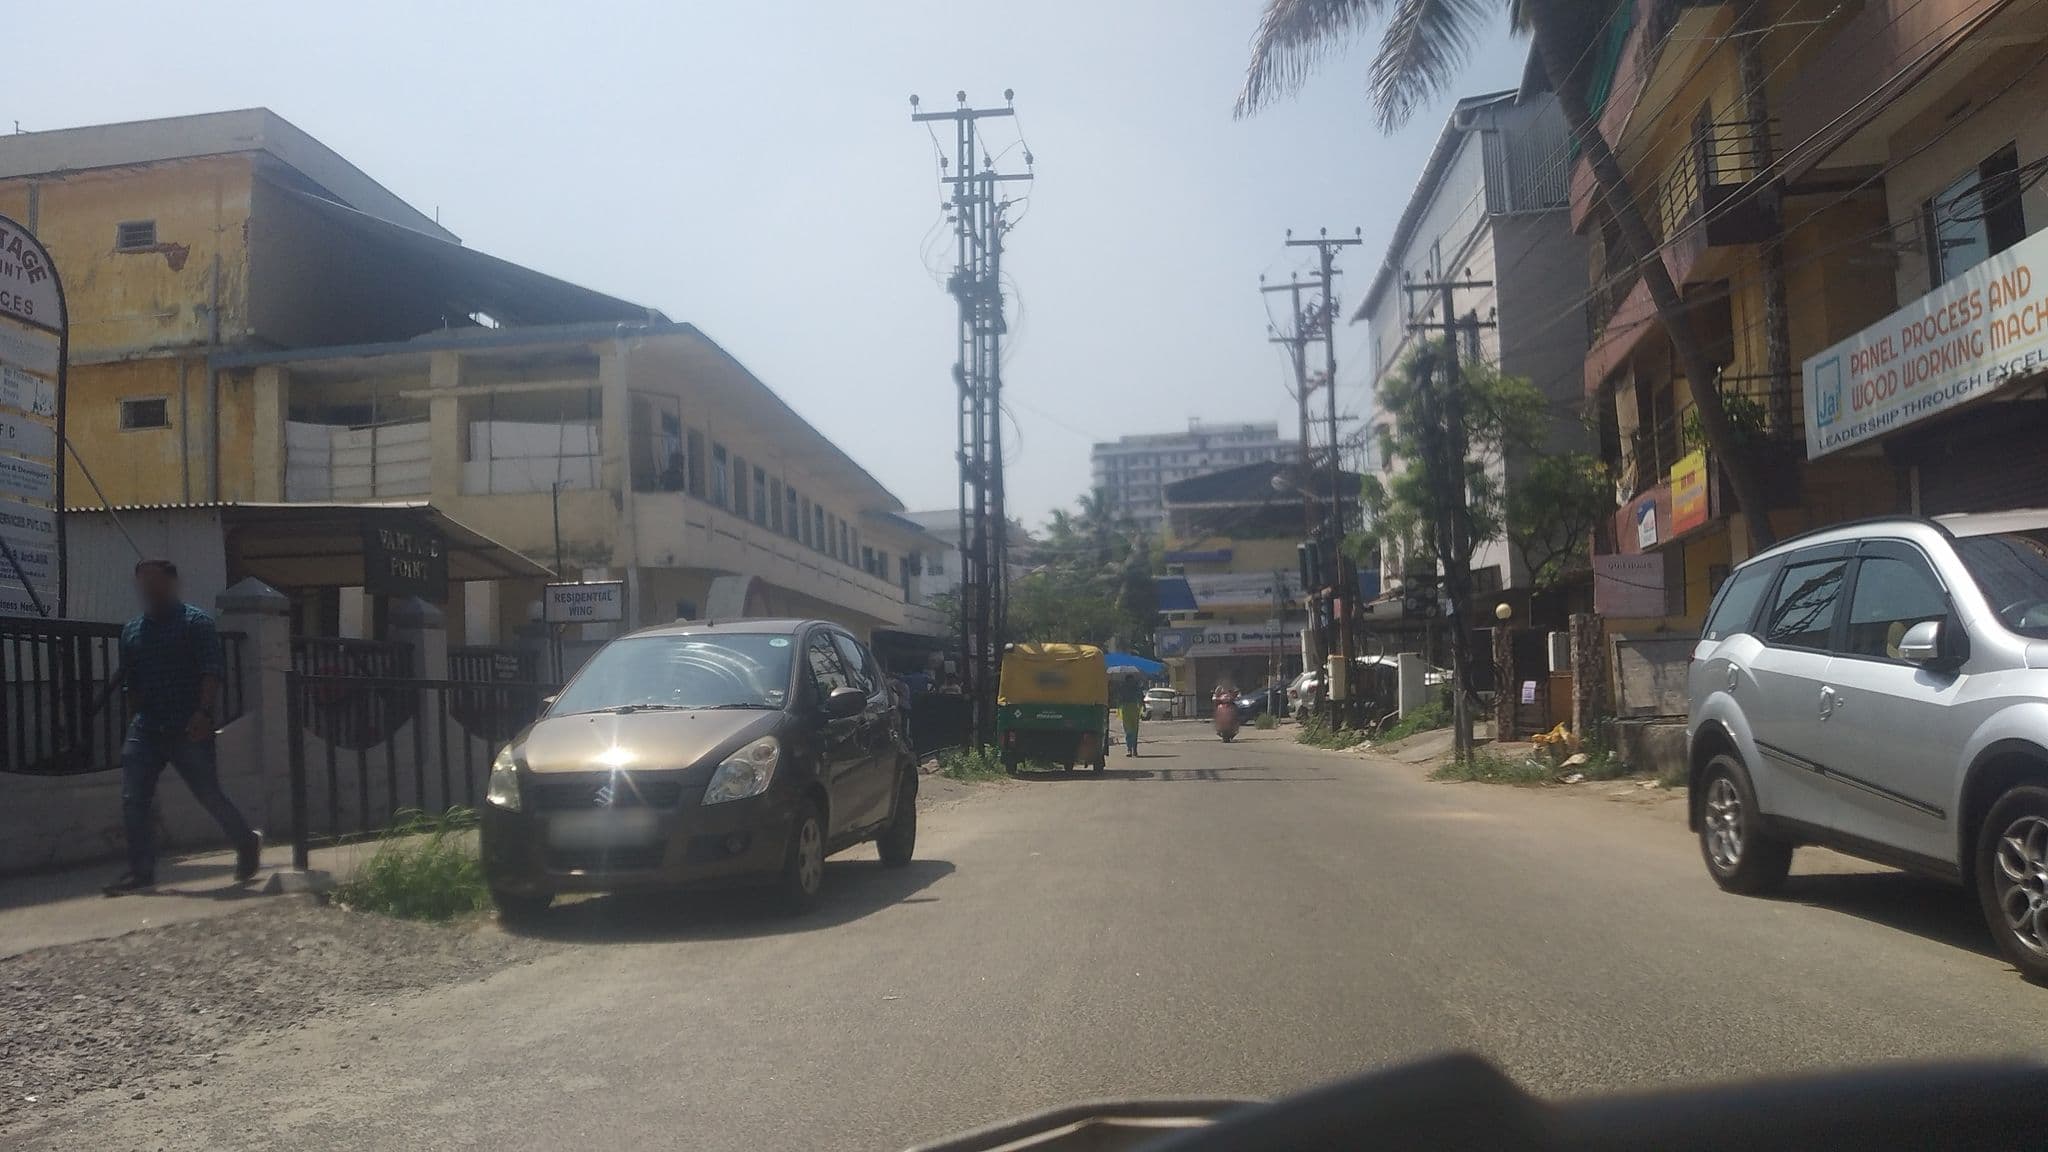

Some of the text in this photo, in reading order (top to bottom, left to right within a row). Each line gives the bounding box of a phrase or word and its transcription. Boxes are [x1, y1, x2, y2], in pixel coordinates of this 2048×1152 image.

[1851, 264, 2031, 377] PANEL PROCESS AND
[1852, 369, 1898, 412] WOOD
[1903, 328, 1985, 389] WORKING
[1818, 386, 1841, 420] Jai
[1819, 407, 1900, 450] LEADERSHIP
[1902, 375, 1981, 416] THROUGH
[554, 590, 613, 604] RESIDENTIAL
[569, 606, 593, 617] WING
